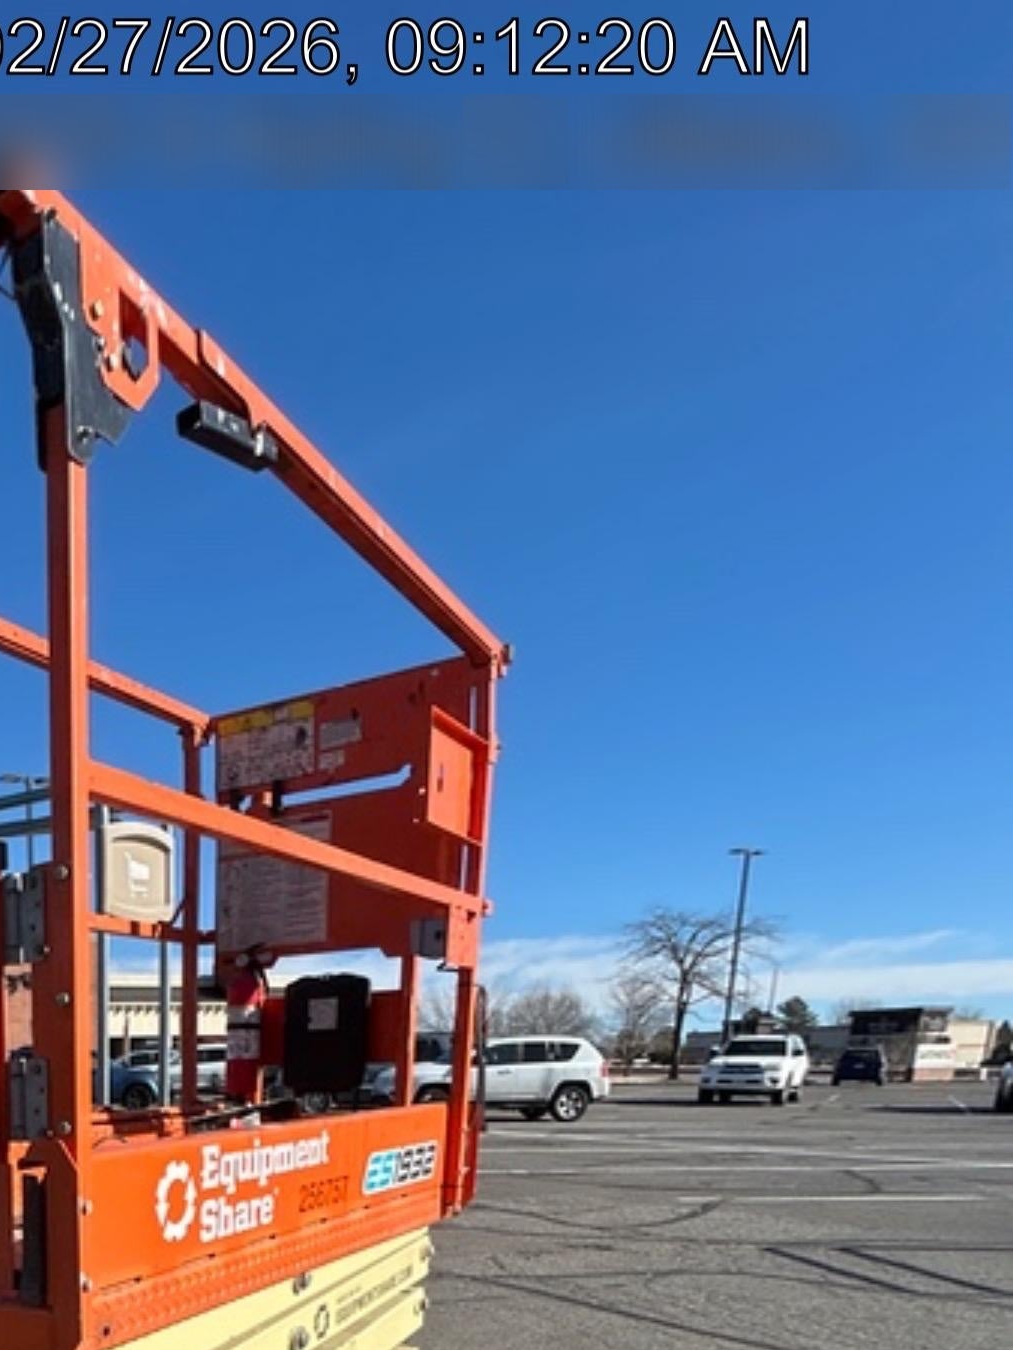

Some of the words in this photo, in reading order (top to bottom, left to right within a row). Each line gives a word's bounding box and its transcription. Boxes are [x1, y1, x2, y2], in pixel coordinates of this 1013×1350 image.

[201, 1129, 330, 1195] Equipment
[298, 1174, 350, 1213] 256757
[199, 1194, 274, 1244] Share
